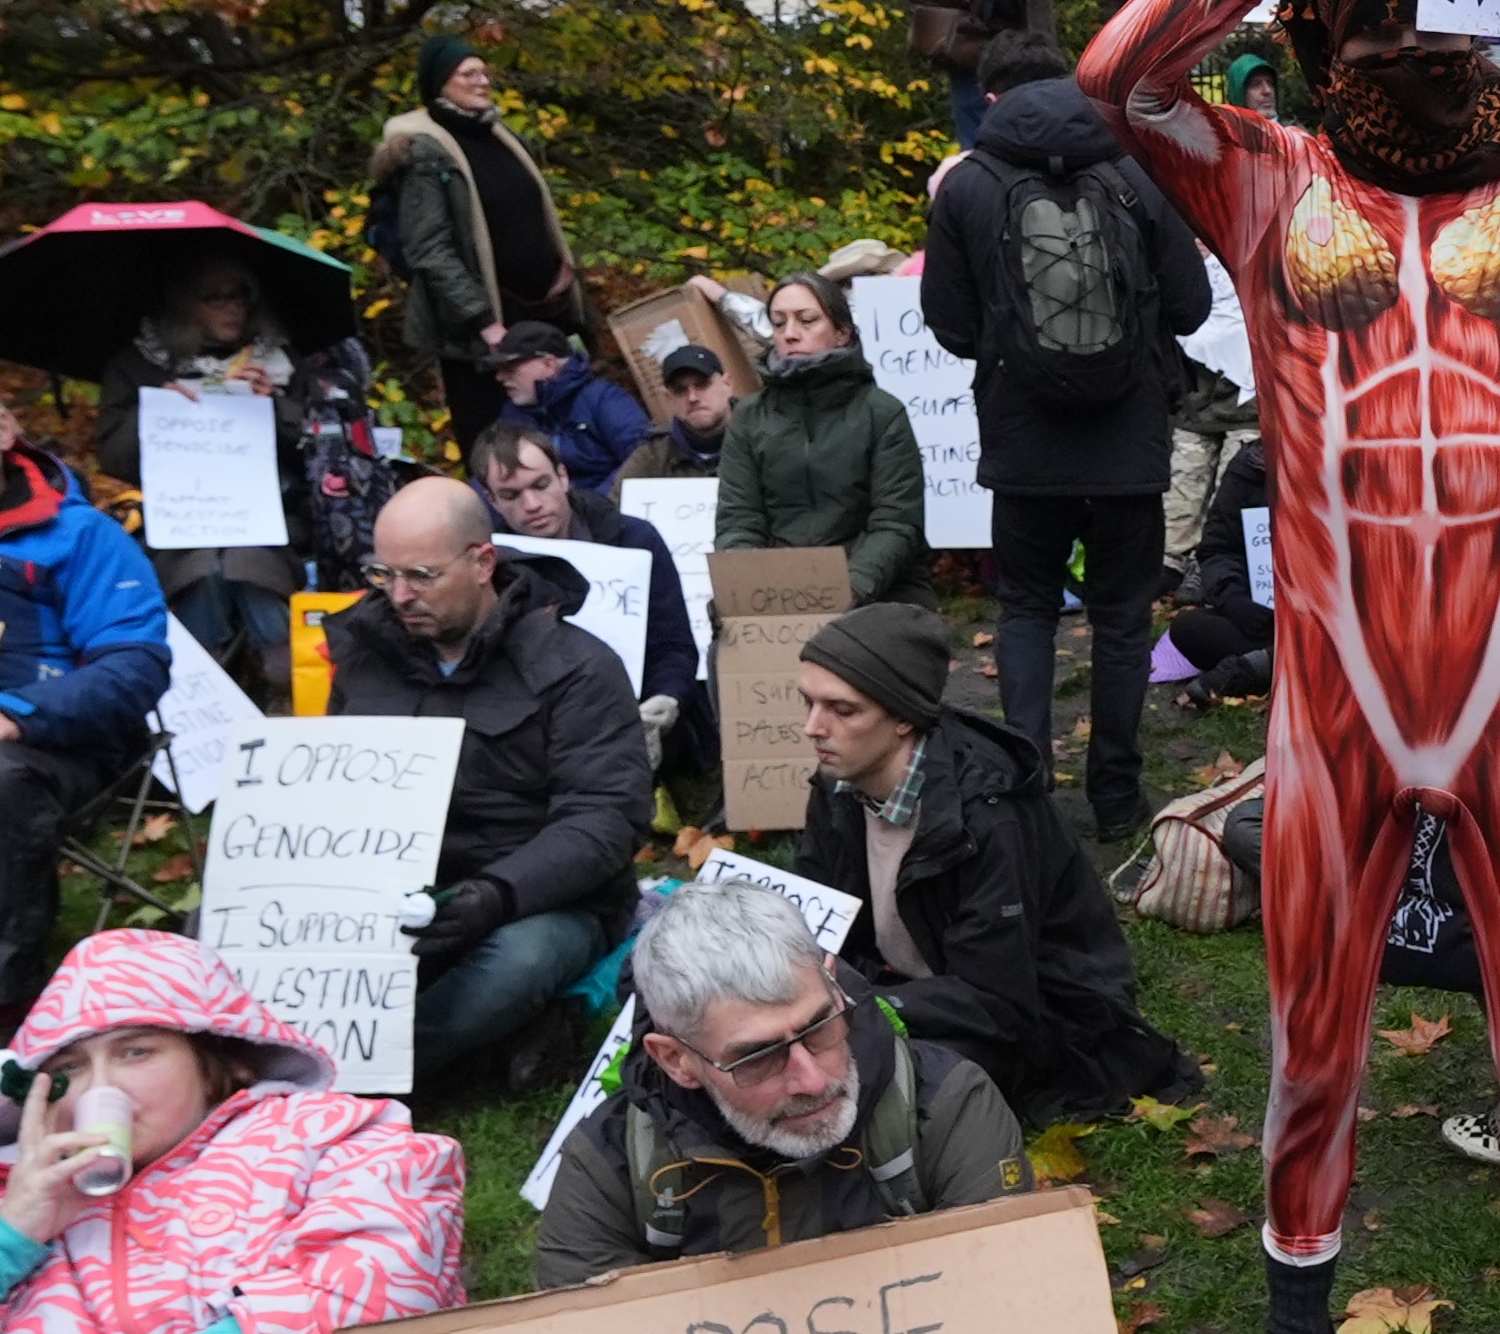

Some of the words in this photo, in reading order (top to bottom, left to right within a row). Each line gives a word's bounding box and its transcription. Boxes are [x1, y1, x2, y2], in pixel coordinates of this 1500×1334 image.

[237, 739, 266, 788] I
[277, 742, 437, 791] OPPOSE
[221, 813, 438, 865] GENOCIDE
[211, 905, 248, 950] I
[257, 900, 403, 950] SUPPORT
